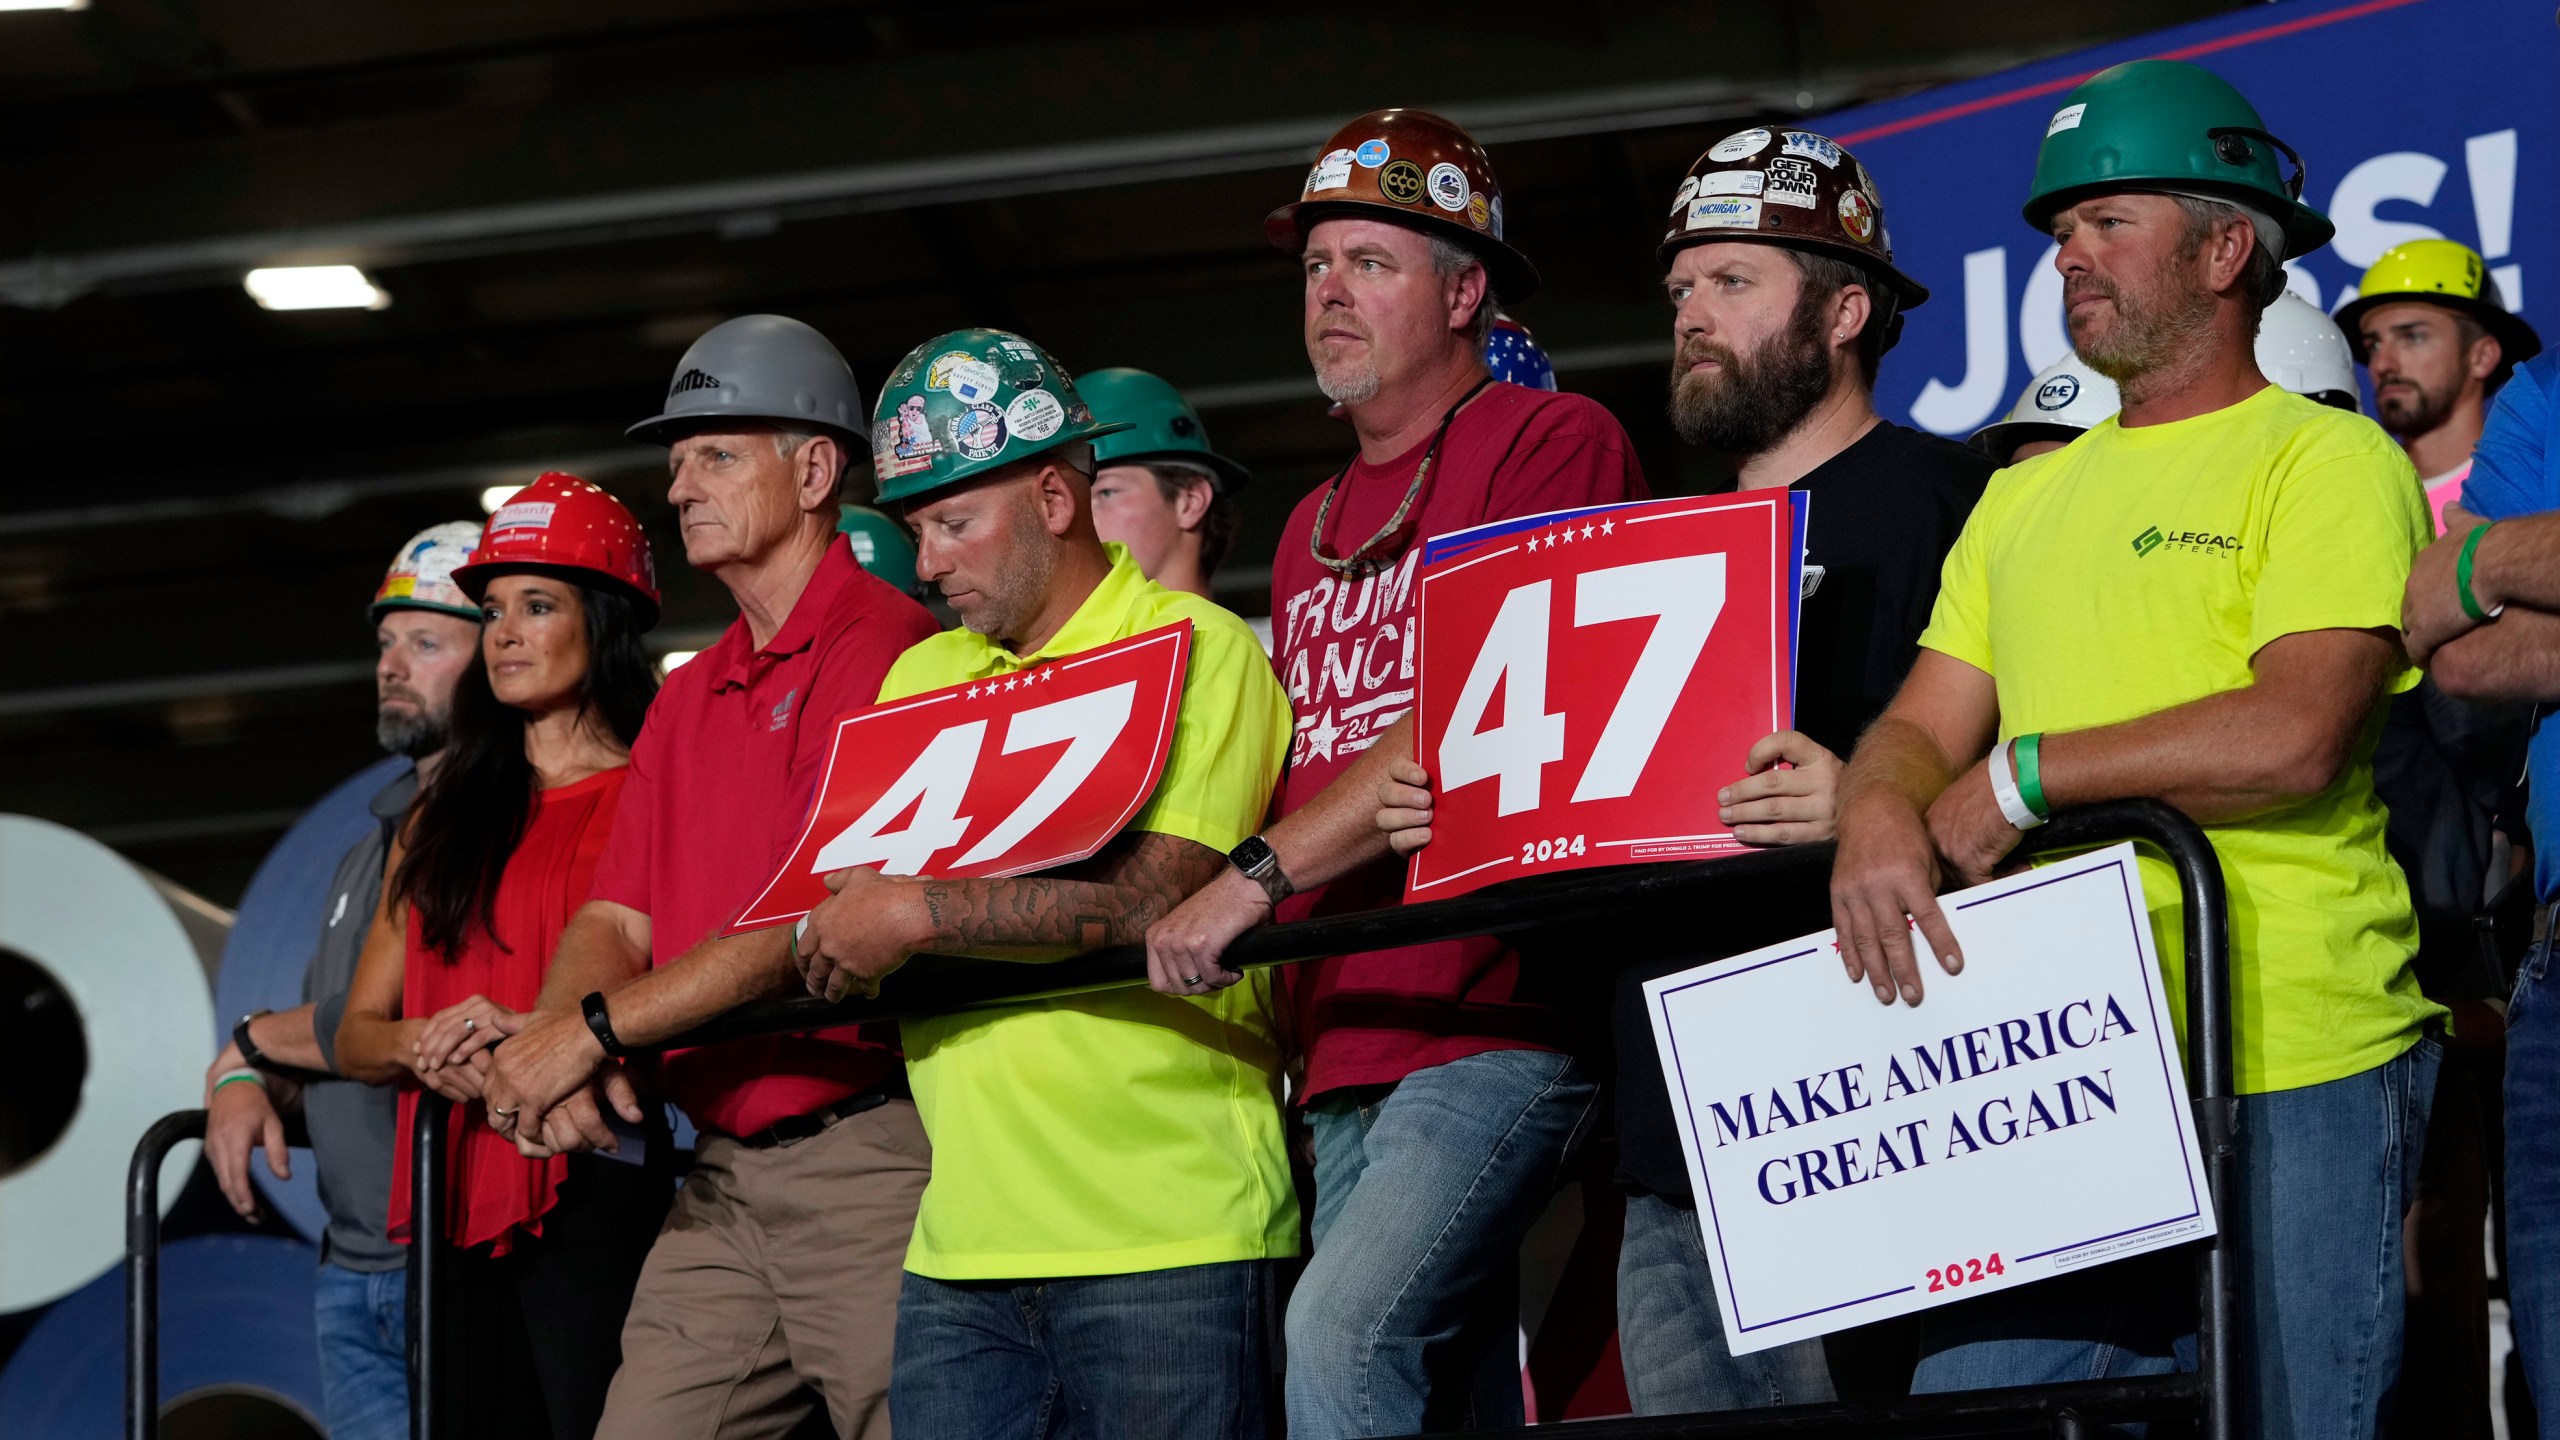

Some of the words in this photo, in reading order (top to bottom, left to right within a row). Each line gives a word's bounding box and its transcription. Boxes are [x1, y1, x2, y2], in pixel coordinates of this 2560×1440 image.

[1768, 169, 1814, 185] YOUR
[1772, 160, 1808, 172] GET
[1388, 173, 1419, 190] CCO
[1772, 180, 1811, 196] OWN
[1698, 204, 1741, 215] MICHIGAN
[1910, 128, 2522, 434] JS!
[2042, 386, 2072, 397] CME
[972, 402, 994, 412] CLASS
[1037, 423, 1050, 433] 168
[2164, 543, 2227, 558] STEEL
[1284, 547, 1420, 658] TRUM
[1283, 617, 1416, 706] ANC
[1438, 552, 1726, 818] 47
[1346, 716, 1369, 740] 24
[810, 680, 1138, 876] 47
[1520, 834, 1586, 866] 2024
[1706, 1064, 1872, 1148] MAKE
[1883, 992, 2138, 1102] AMERICA
[1757, 1118, 1930, 1206] GREAT
[1946, 1068, 2118, 1158] AGAIN
[2090, 1246, 2111, 1256] DONALD
[2147, 1230, 2174, 1240] PRESIDENT
[1926, 1253, 2004, 1293] 2024
